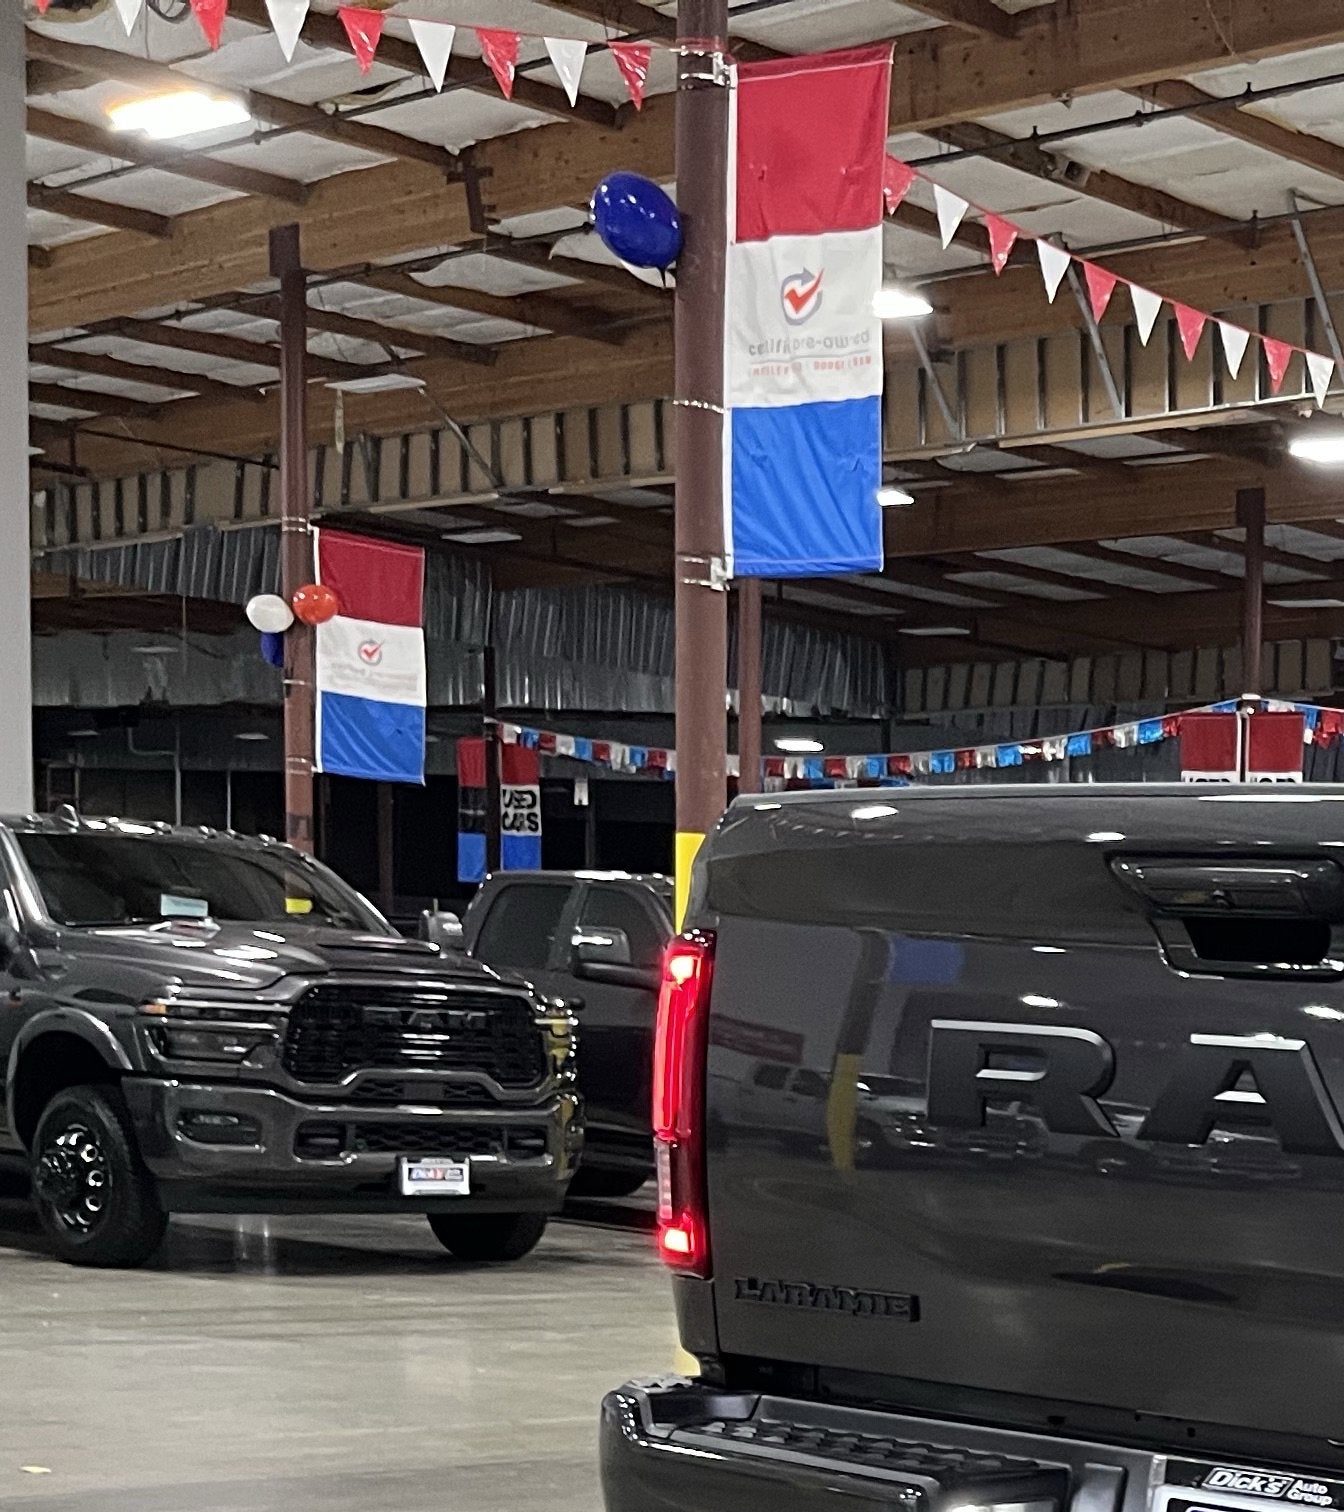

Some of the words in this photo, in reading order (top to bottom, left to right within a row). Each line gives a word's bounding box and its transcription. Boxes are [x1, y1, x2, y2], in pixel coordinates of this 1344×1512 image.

[735, 1277, 920, 1322] LARAMIE
[1208, 1470, 1284, 1494] Dick's
[1292, 1479, 1329, 1495] Auto
[1286, 1488, 1333, 1506] Group
